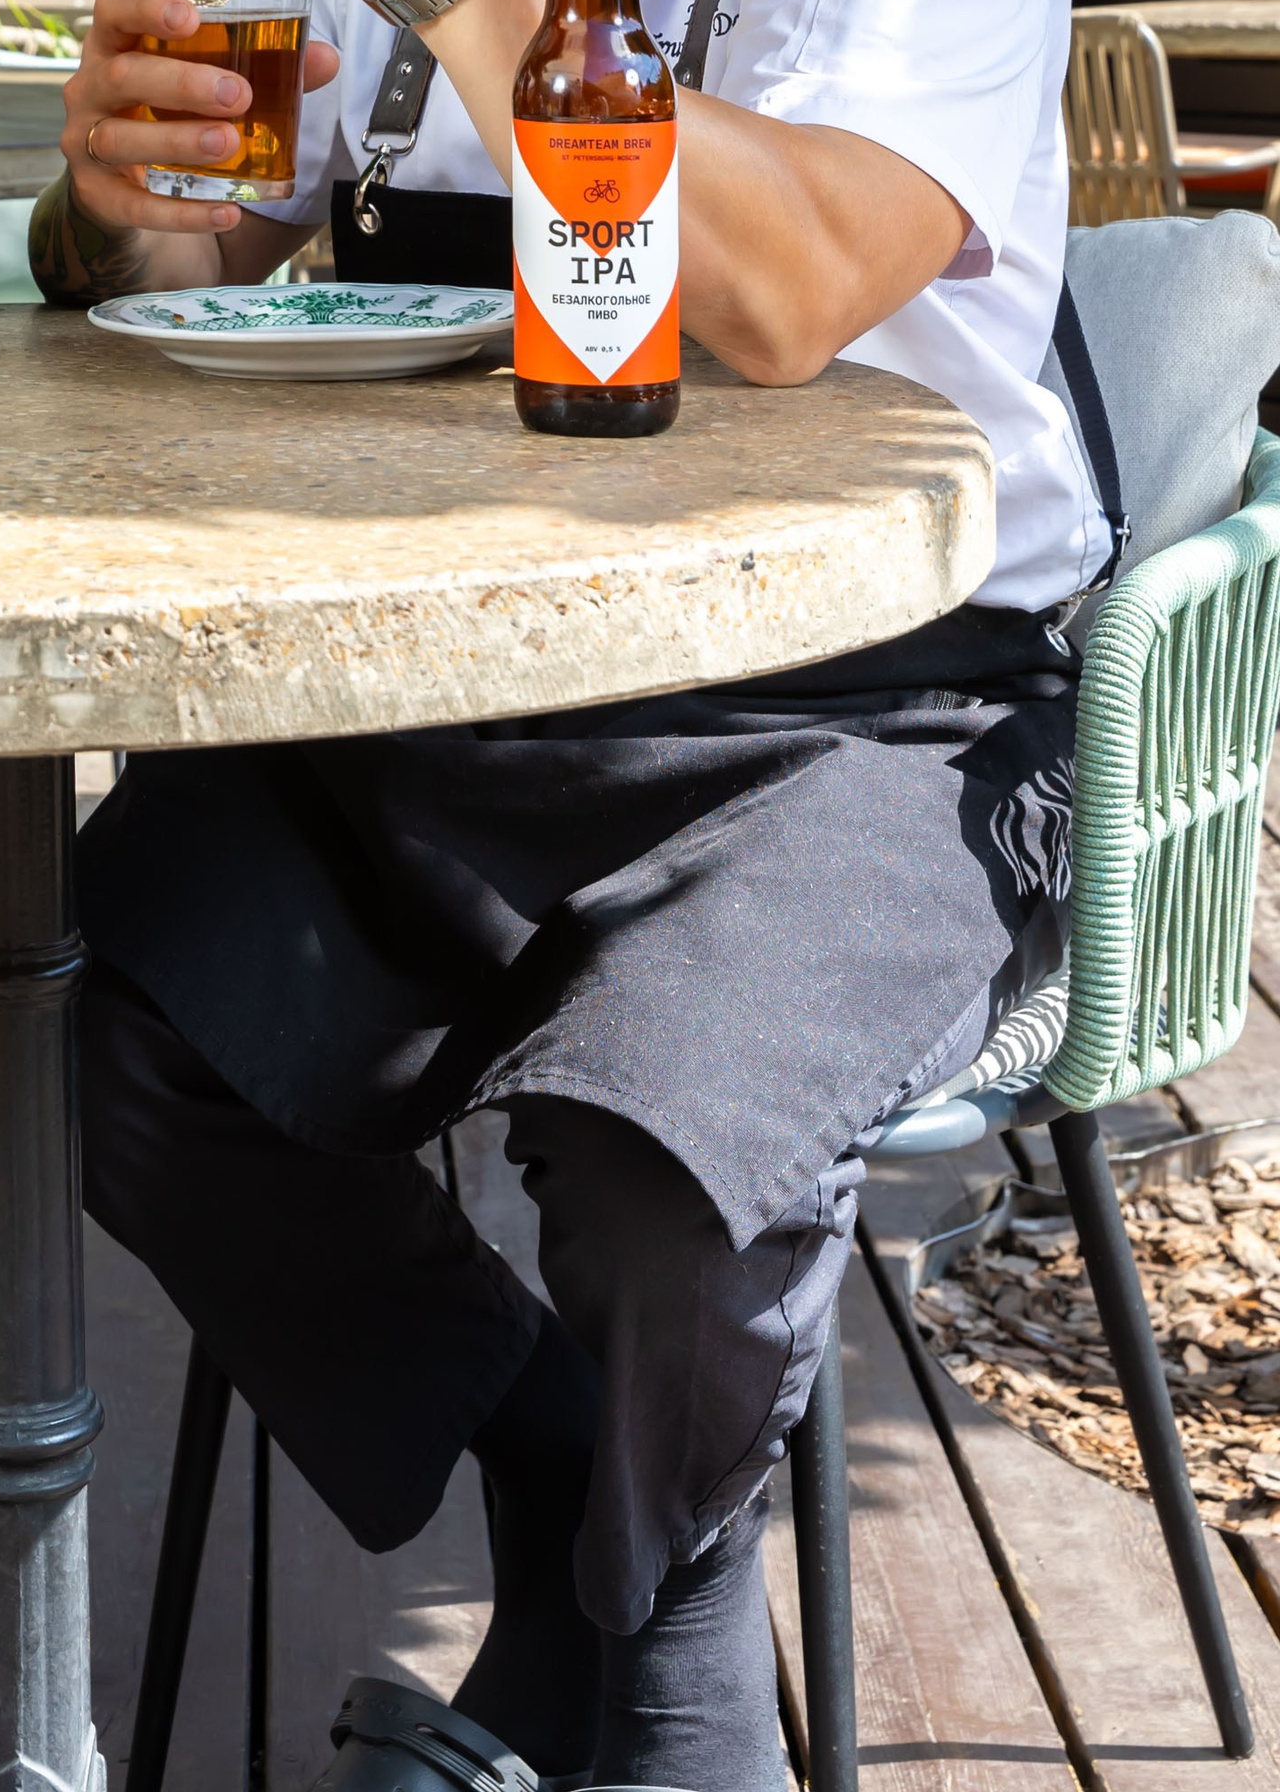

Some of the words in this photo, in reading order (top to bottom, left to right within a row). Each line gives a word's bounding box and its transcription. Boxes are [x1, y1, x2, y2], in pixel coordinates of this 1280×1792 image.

[549, 138, 619, 149] DREAMTEAM
[624, 138, 652, 149] BREW
[548, 219, 654, 248] SPORT
[571, 257, 636, 284] IPA
[552, 294, 651, 306] БЕЗАЛКОГОЛЬНОЕ
[587, 310, 618, 320] ПИВО
